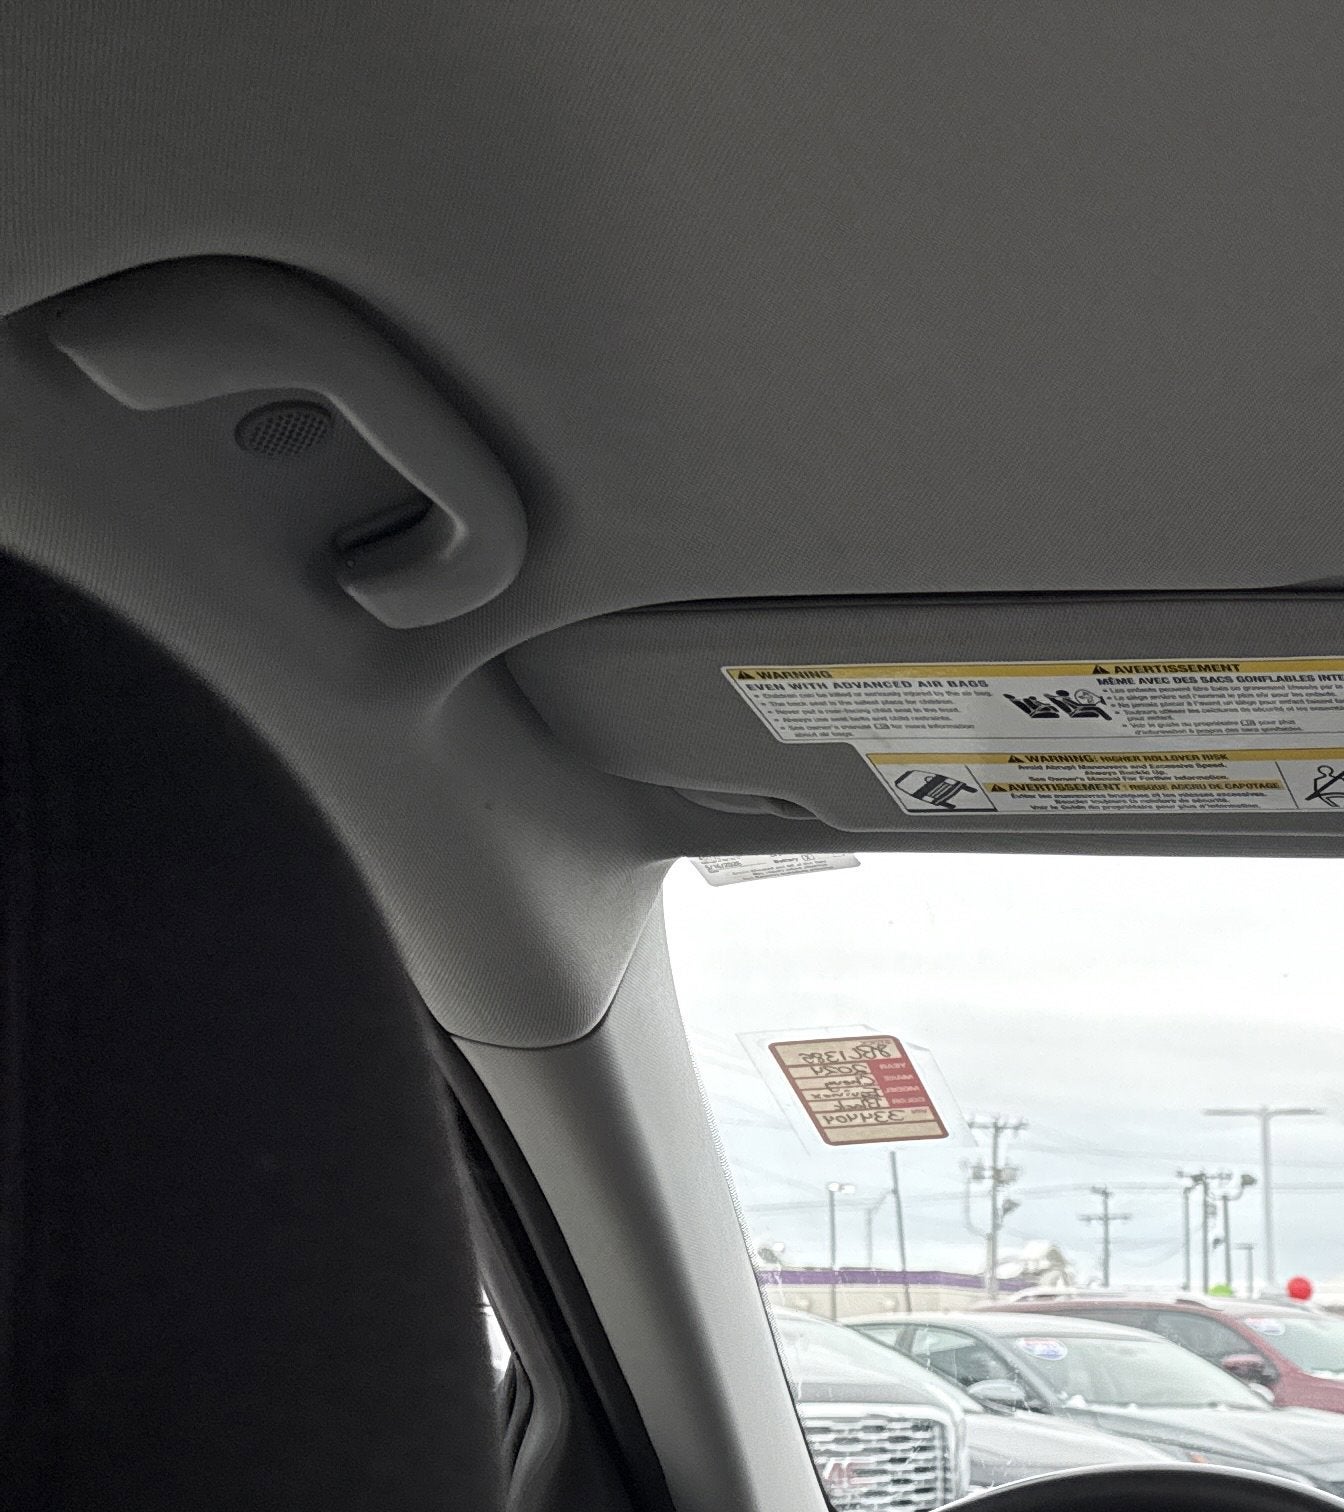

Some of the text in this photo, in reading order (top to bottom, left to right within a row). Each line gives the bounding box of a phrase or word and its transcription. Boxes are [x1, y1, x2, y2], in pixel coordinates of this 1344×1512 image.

[1113, 663, 1240, 674] AVERTISSEMENT
[756, 670, 833, 680] WARNING
[1138, 677, 1171, 685] AVEC
[1173, 676, 1198, 684] DES
[1199, 675, 1234, 684] SACS
[1236, 675, 1316, 683] GONFLABLES
[745, 680, 989, 691] EVEN WITH ADVANCED AIR BAGS
[1201, 753, 1229, 761] RISK
[1008, 783, 1120, 792] AVERTISSEMENT
[1129, 783, 1169, 791] RISQUE
